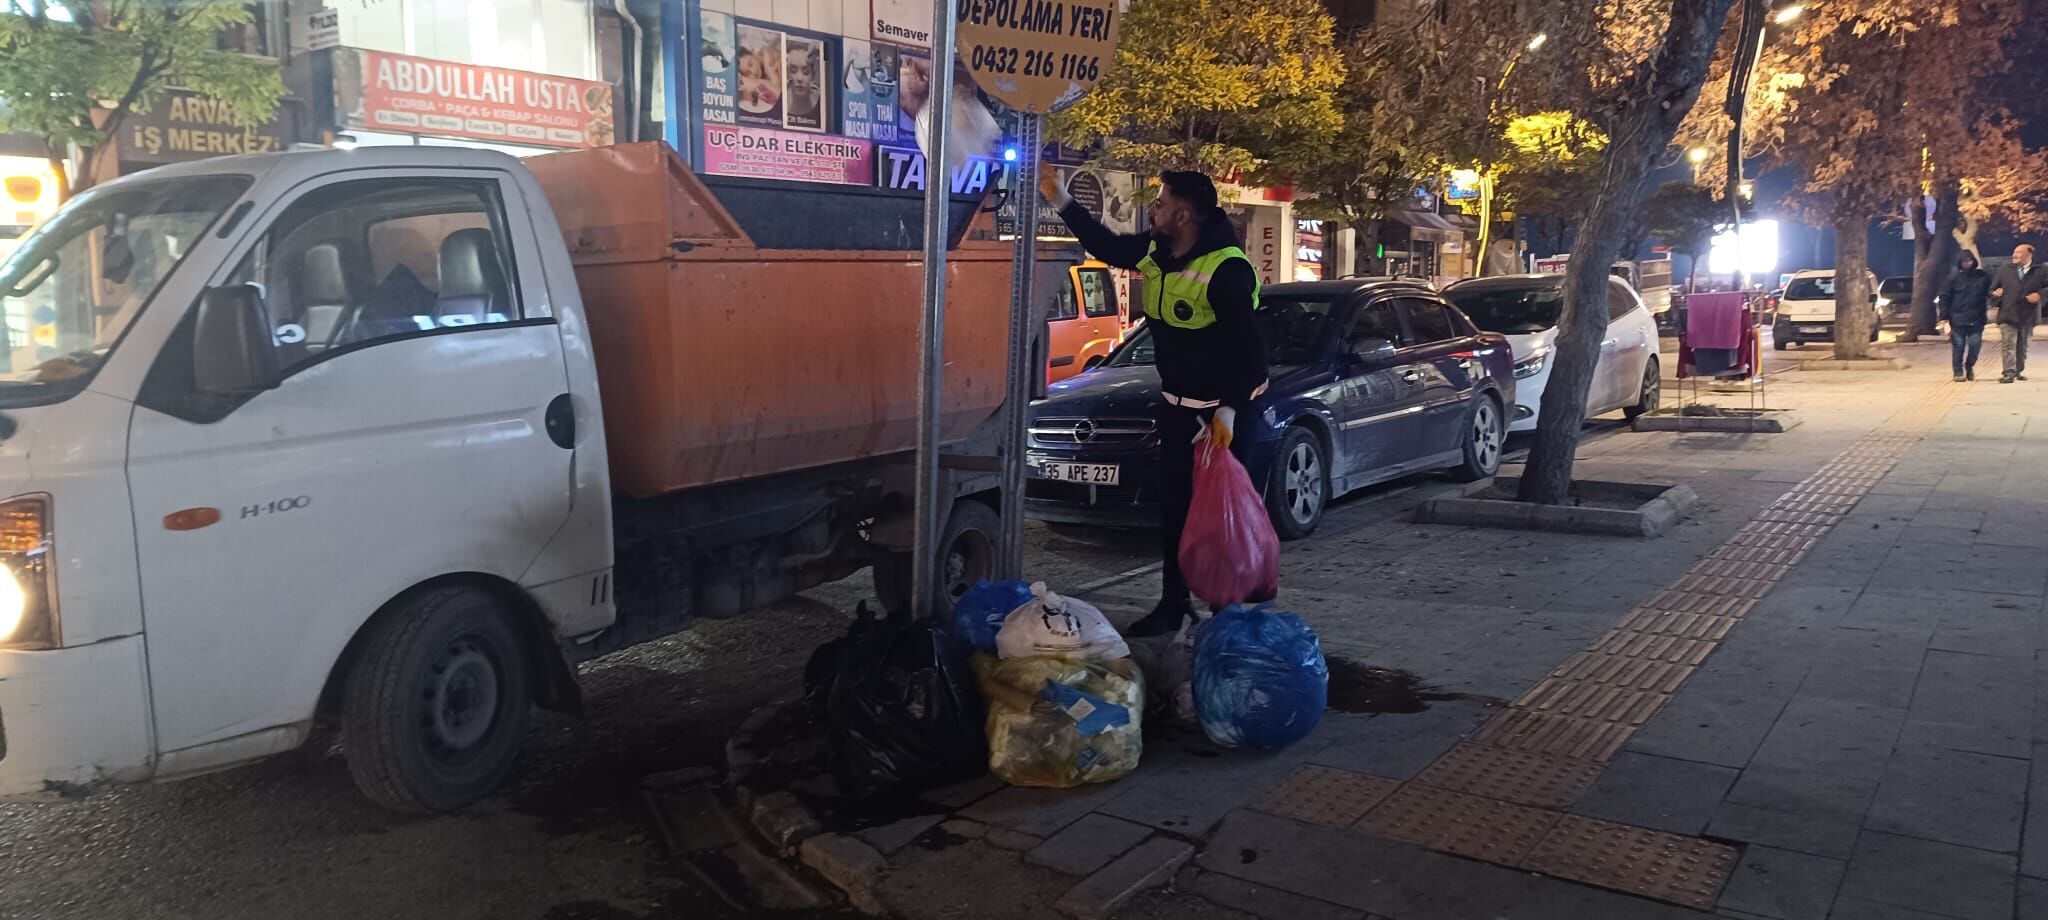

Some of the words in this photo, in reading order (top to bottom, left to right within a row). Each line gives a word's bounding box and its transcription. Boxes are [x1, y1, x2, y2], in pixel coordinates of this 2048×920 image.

[877, 20, 928, 41] Semaver
[958, 0, 1063, 35] DEPOLAMA
[1069, 3, 1113, 42] YERİ
[971, 44, 1018, 74] 0432
[1024, 49, 1054, 77] 216
[1060, 53, 1099, 82] 1166
[376, 58, 515, 105] ABDULLAH
[523, 77, 582, 113] USTA
[706, 76, 727, 92] BAŞ
[848, 101, 868, 120] SPOR
[134, 125, 162, 154] İŞ
[709, 131, 780, 152] UÇ-DAR
[785, 140, 860, 158] ELEKTRİK
[1046, 464, 1060, 479] 35
[1067, 465, 1089, 481] APE
[1094, 466, 1117, 482] 237
[241, 495, 312, 519] H-100
